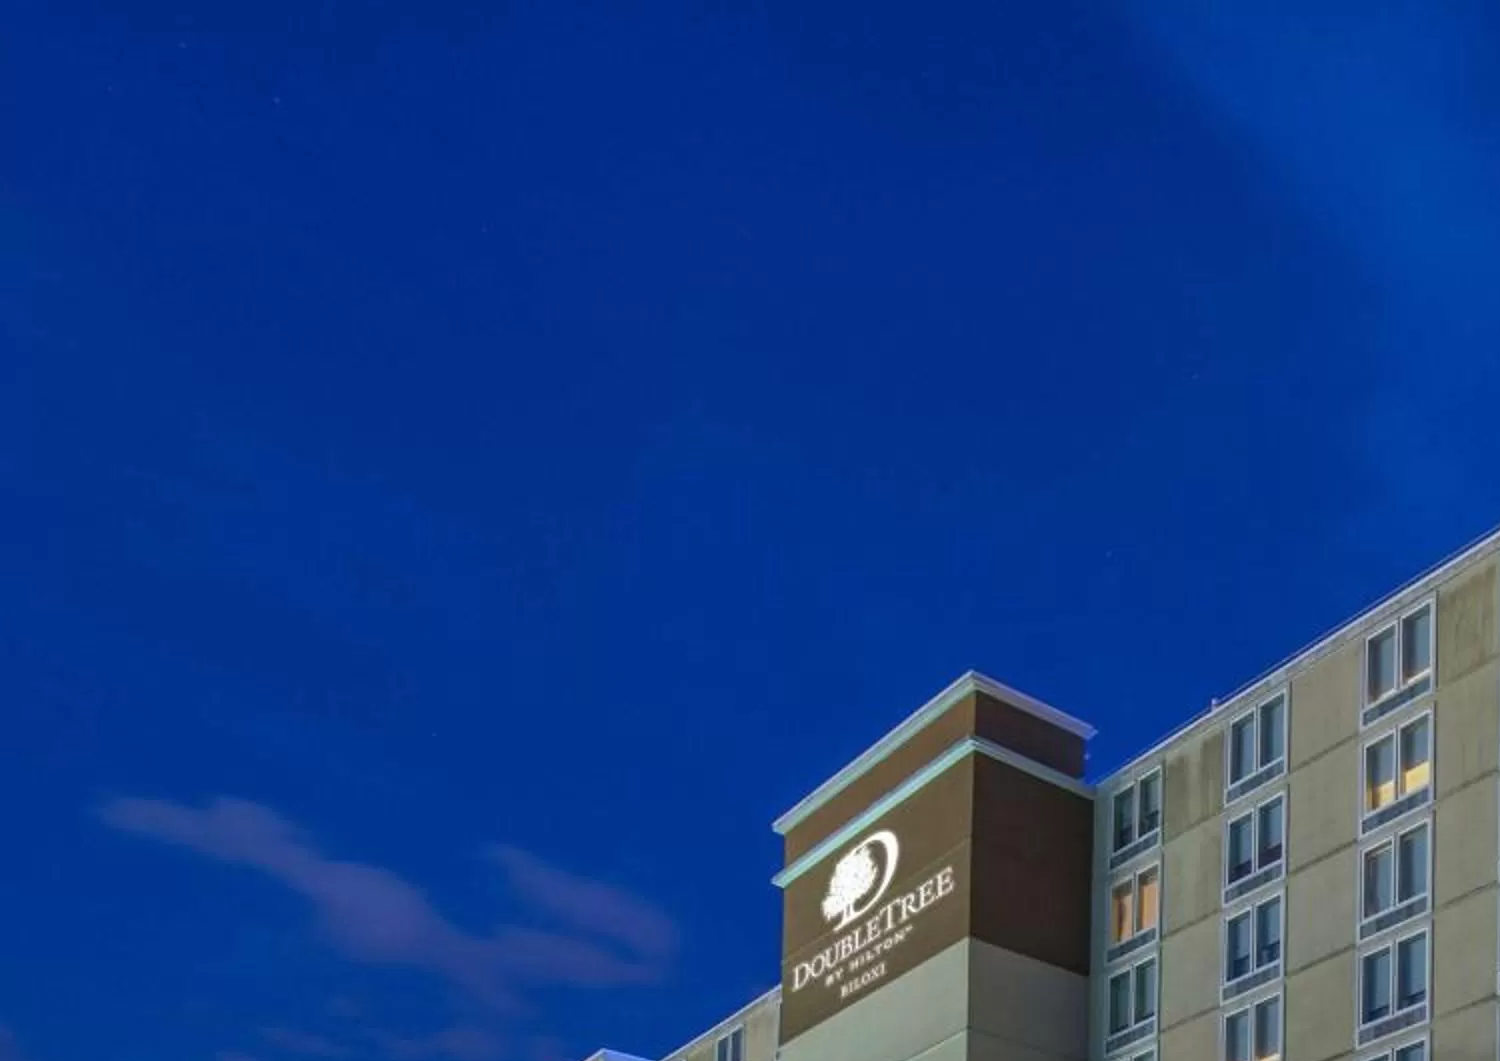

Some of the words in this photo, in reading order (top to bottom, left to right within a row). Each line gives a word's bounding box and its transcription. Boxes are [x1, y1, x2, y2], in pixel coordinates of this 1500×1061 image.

[792, 866, 955, 993] DOUBLETREE
[824, 966, 845, 988] BY
[848, 929, 906, 973] HILTON
[840, 961, 887, 999] BILOXI
